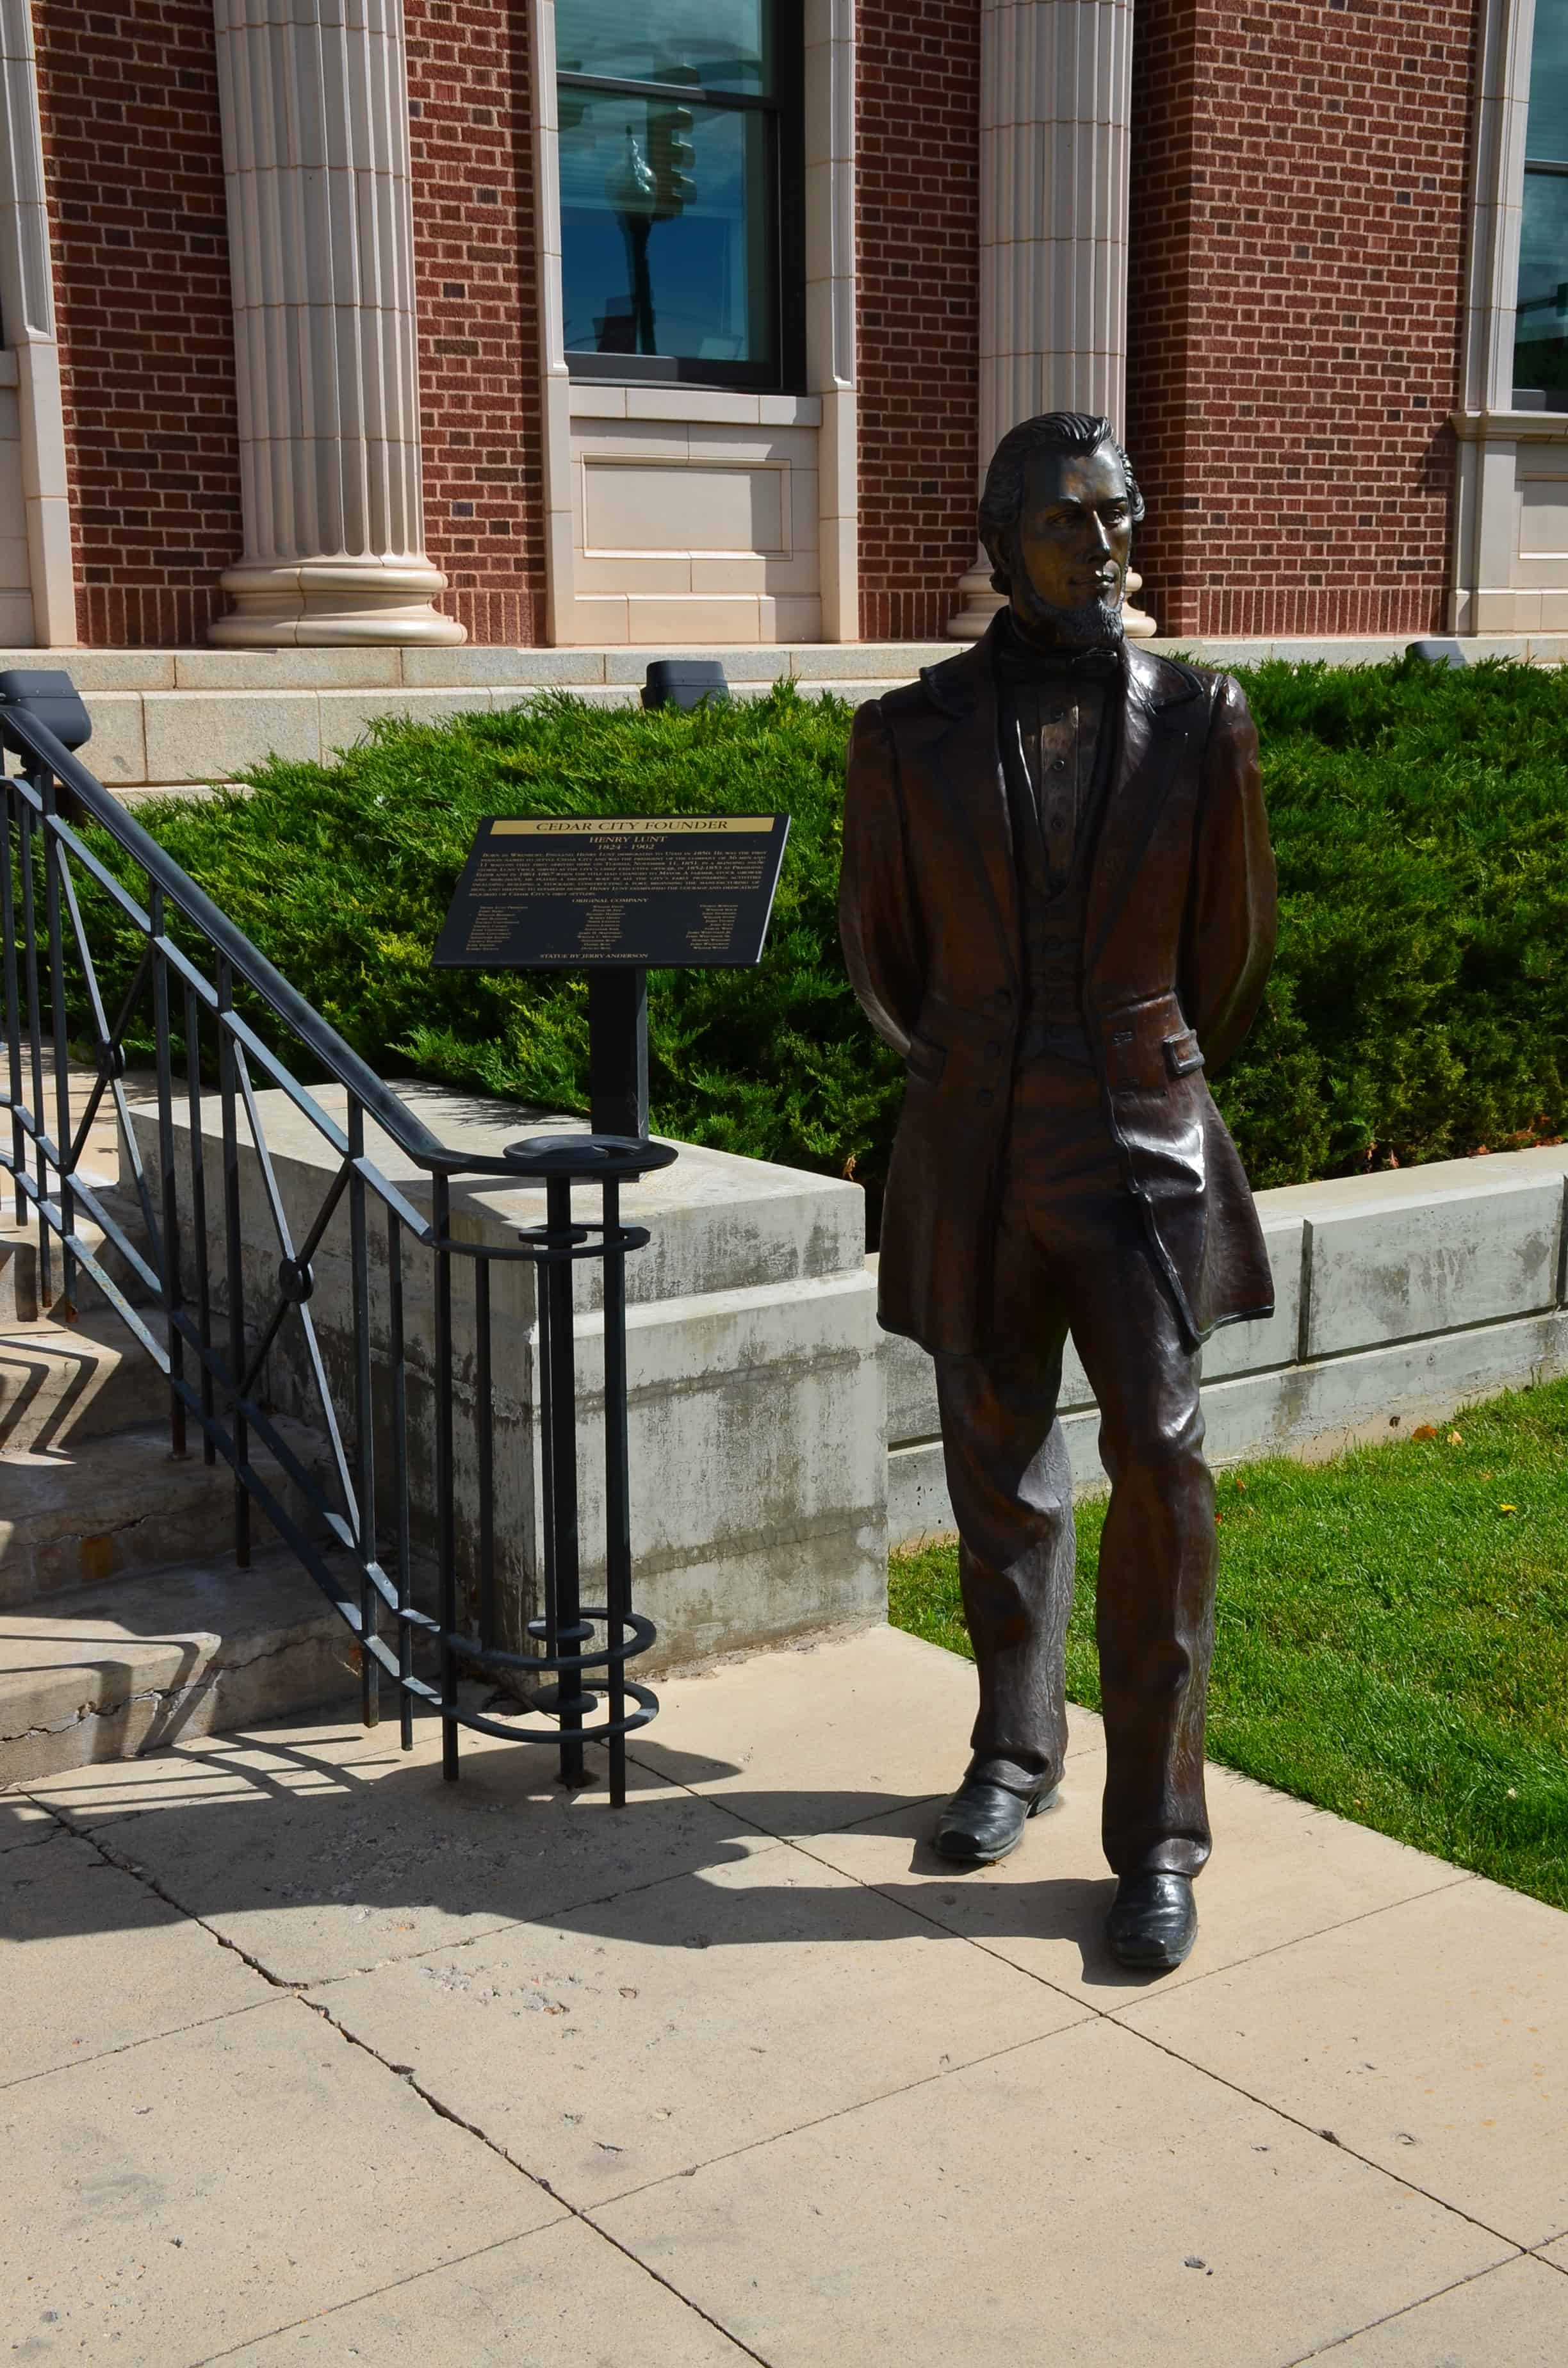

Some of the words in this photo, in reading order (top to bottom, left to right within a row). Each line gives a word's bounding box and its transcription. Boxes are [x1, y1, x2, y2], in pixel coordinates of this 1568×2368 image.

[536, 823, 592, 831] CEDAR
[598, 821, 639, 830] CITY
[645, 820, 728, 829] FOUNDER
